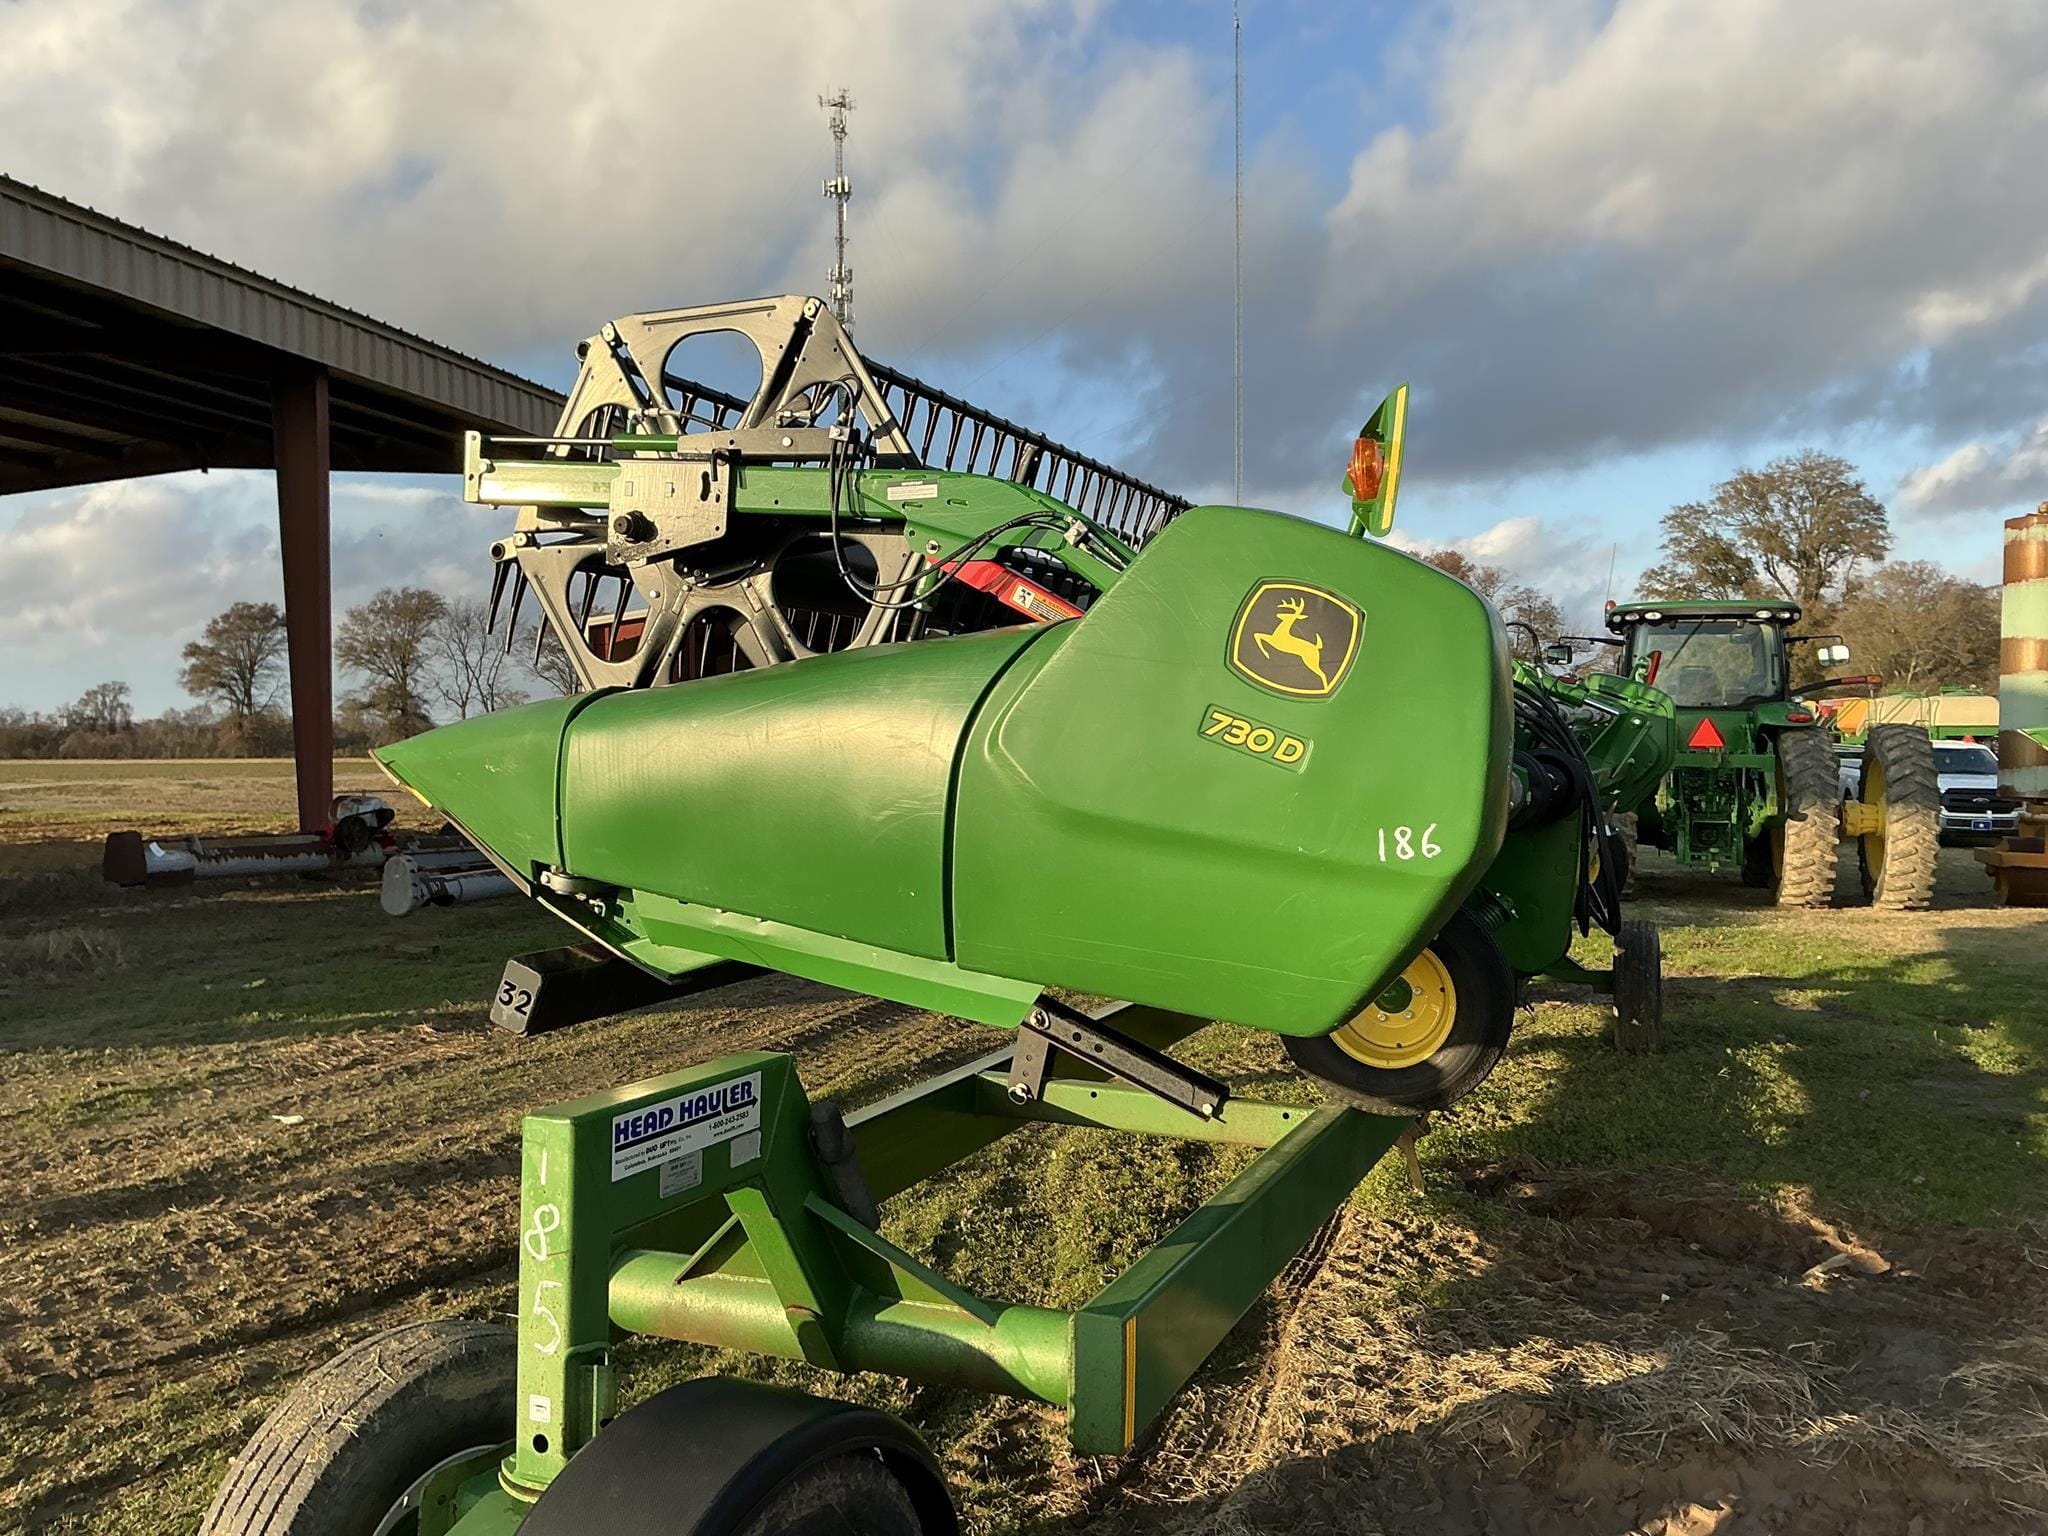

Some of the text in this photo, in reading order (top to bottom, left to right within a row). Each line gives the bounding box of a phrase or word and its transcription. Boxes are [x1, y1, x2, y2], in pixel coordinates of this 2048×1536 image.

[1377, 822, 1441, 862] 186
[499, 980, 531, 1016] 32
[615, 1080, 752, 1144] HEAD HAULER
